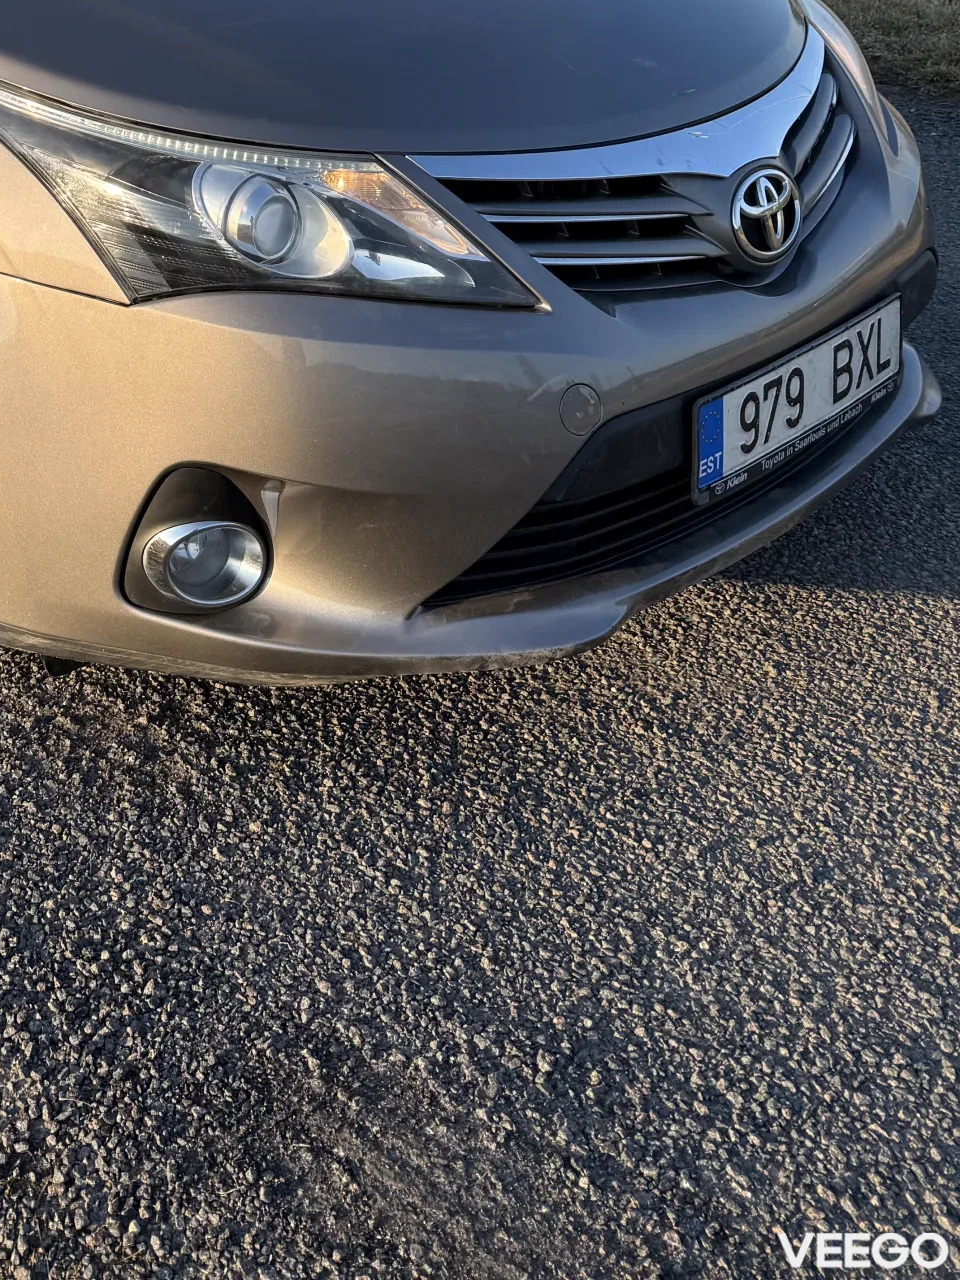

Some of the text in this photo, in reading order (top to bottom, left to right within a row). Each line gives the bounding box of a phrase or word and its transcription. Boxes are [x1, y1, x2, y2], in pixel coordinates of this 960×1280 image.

[739, 317, 891, 454] 979 BXL
[698, 451, 723, 478] EST
[725, 387, 887, 490] Klein Toyota in Saarlouis und Lebach Klein
